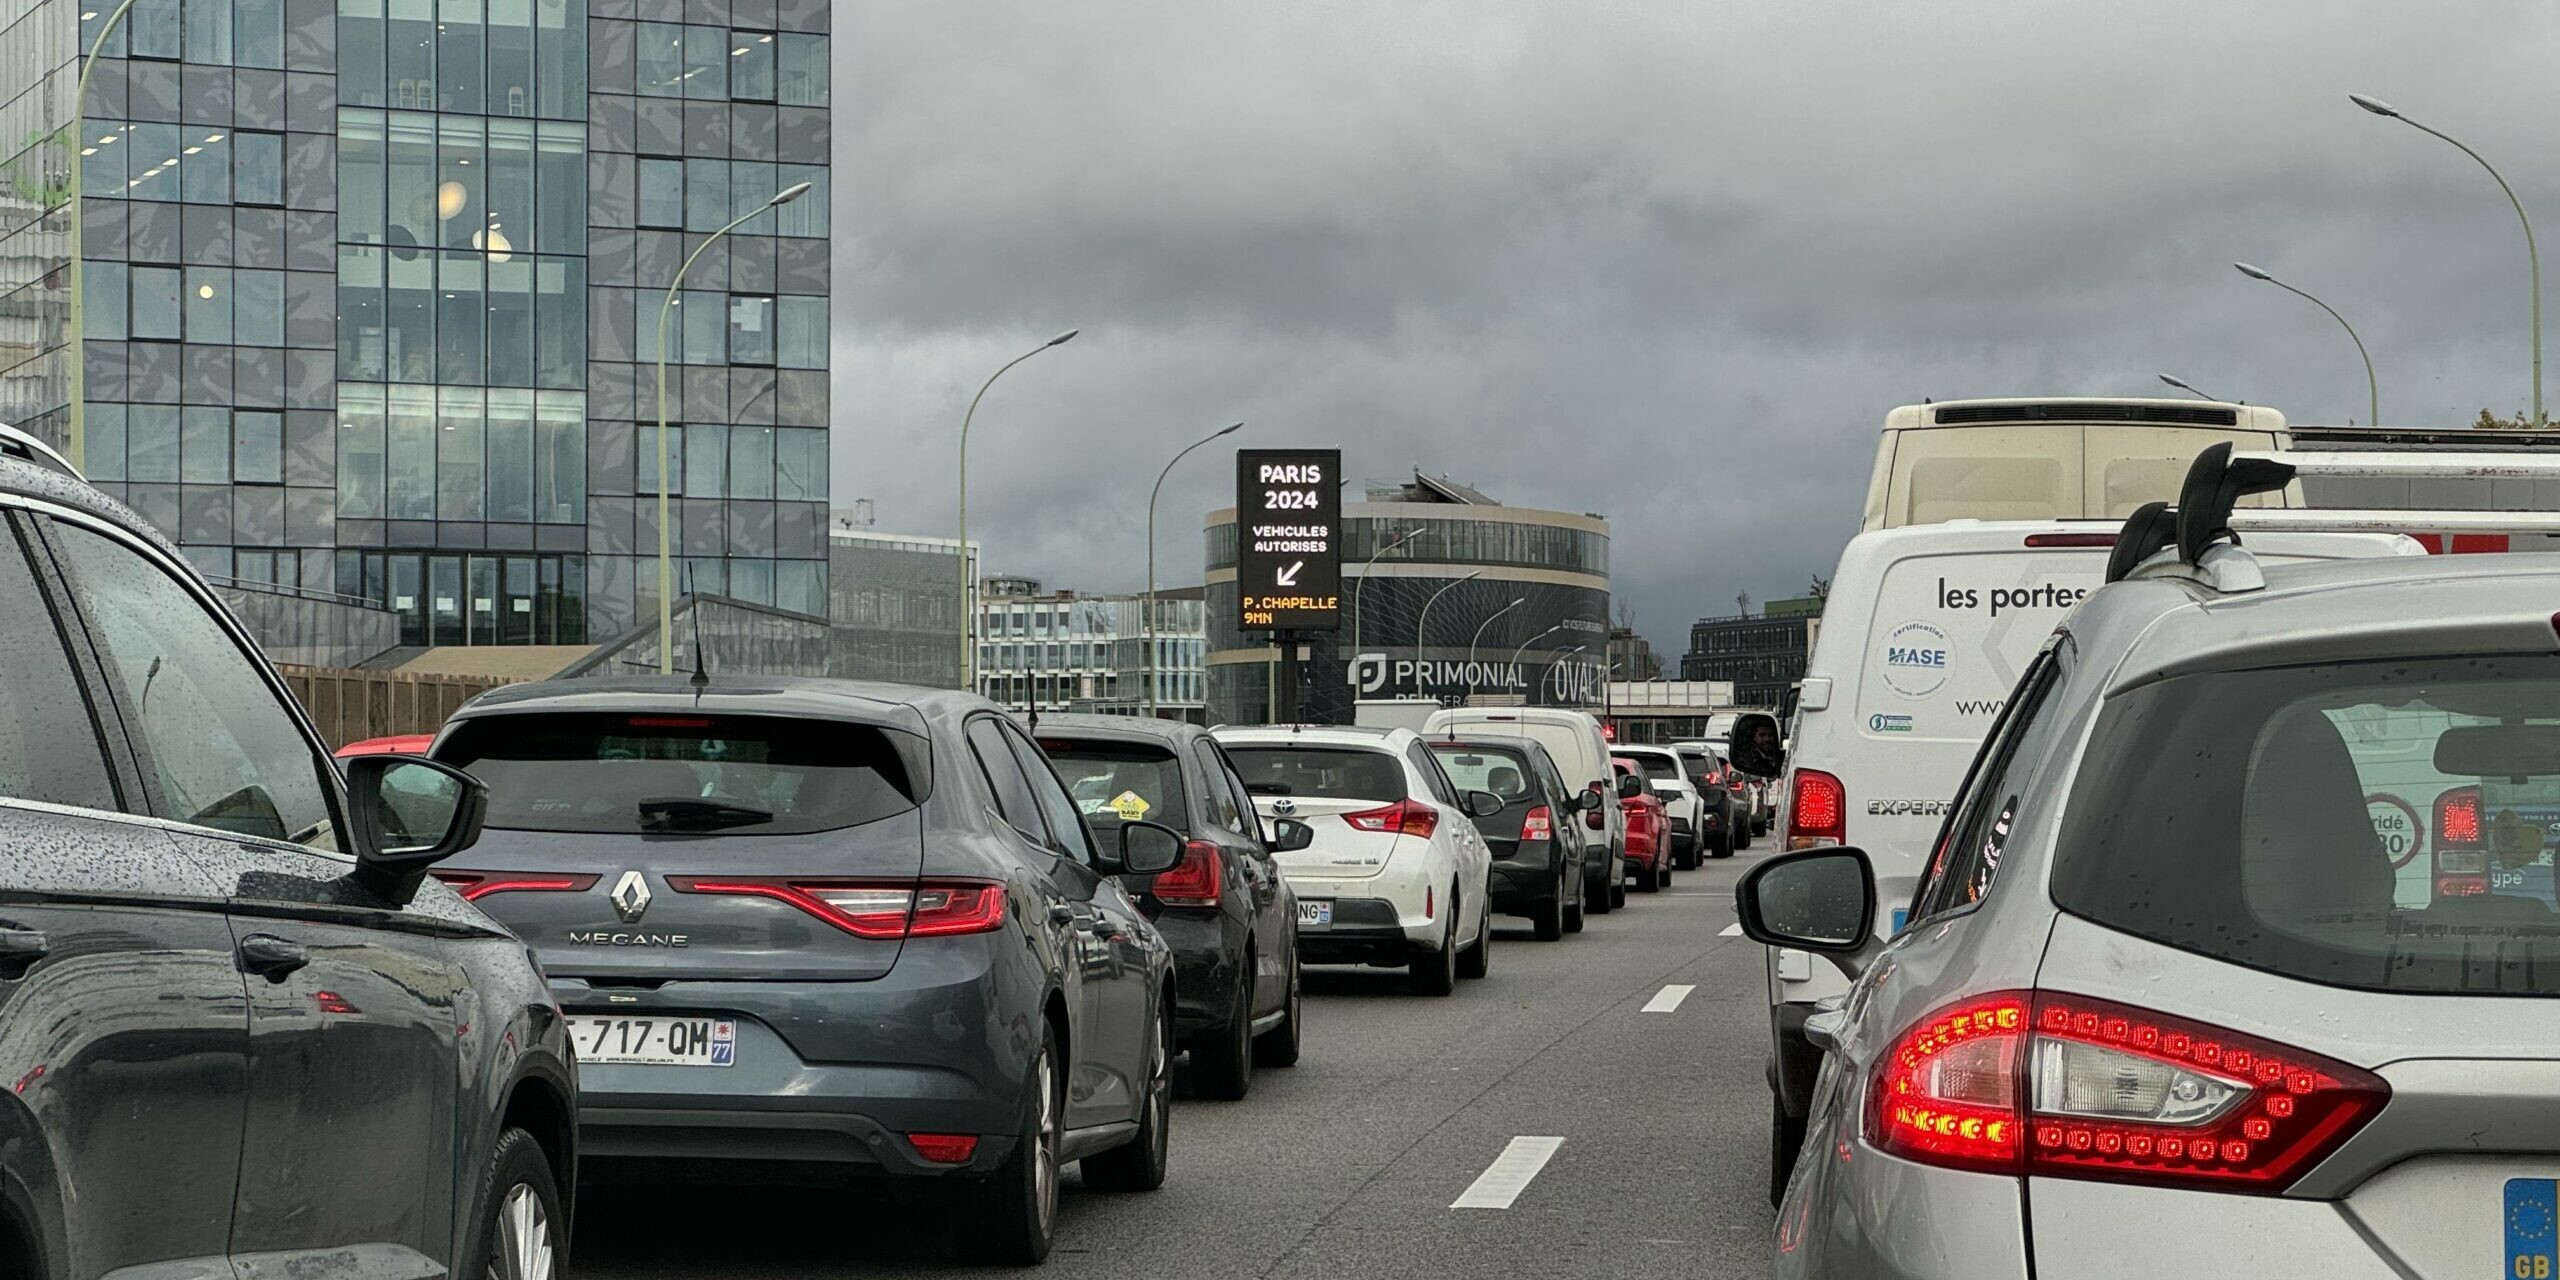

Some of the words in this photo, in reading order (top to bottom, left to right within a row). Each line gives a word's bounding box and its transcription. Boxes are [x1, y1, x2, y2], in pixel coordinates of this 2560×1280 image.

[1260, 464, 1321, 484] PARIS
[1264, 490, 1319, 510] 2024
[1252, 525, 1329, 538] VEHICULES
[1254, 541, 1328, 553] AUTORISES
[1243, 596, 1338, 610] P.CHAPELLE
[1938, 577, 1978, 609] les
[1990, 583, 2087, 618] portes
[1243, 612, 1274, 625] 9MN
[1893, 623, 1945, 640] certification
[1888, 647, 1946, 665] MASE
[1395, 661, 1528, 688] PRIMONIAL
[1955, 700, 2005, 717] ww
[1867, 799, 1952, 816] EXPERT
[1299, 904, 1318, 919] NG
[570, 932, 689, 948] MEGANE
[712, 1043, 731, 1059] 77
[2515, 1255, 2549, 1279] GB
